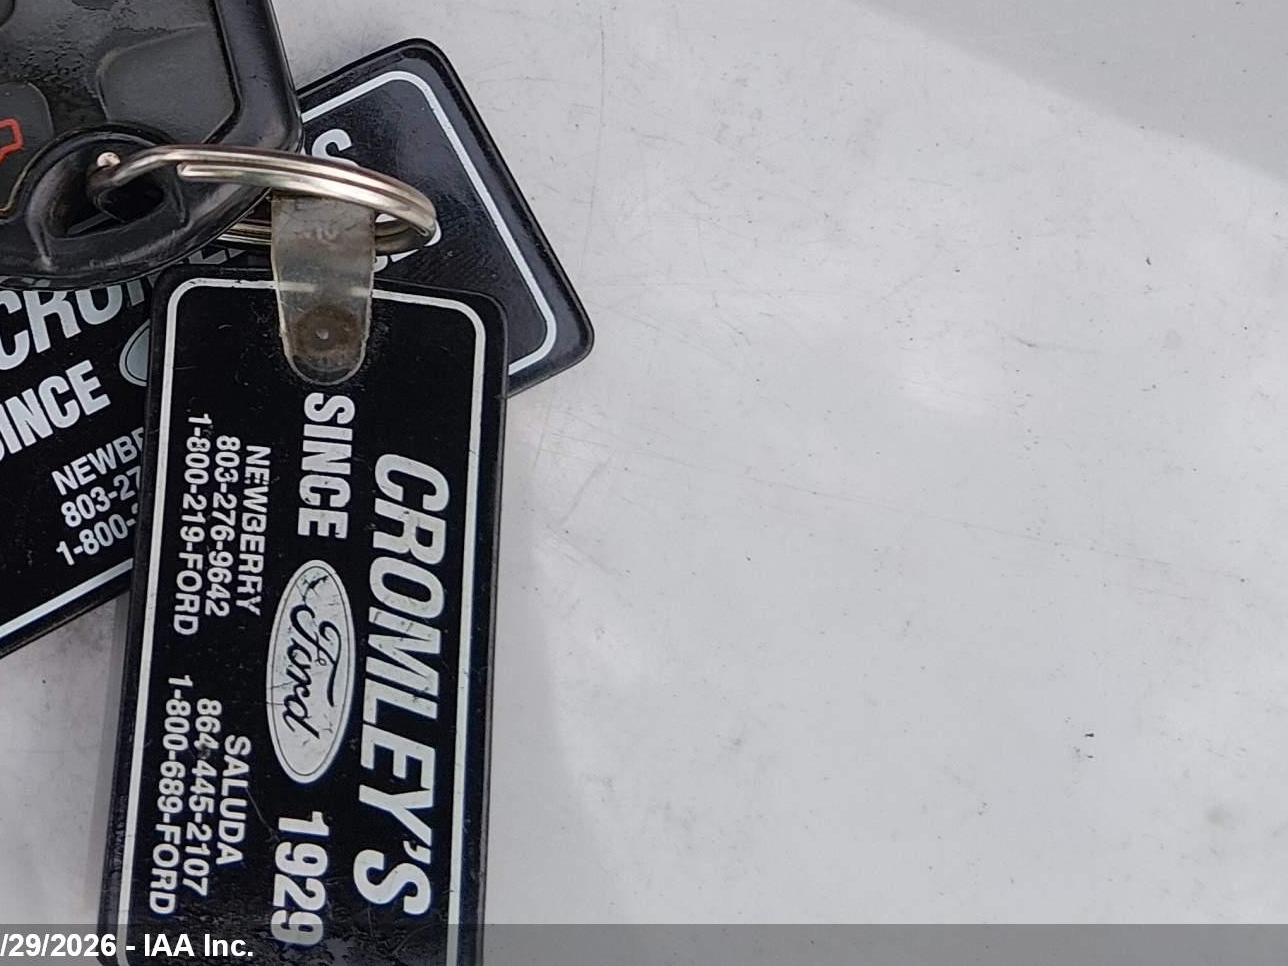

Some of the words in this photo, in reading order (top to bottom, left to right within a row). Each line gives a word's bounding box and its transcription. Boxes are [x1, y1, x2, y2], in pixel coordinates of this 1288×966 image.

[56, 502, 139, 566] 1-800-
[173, 413, 212, 636] 1-800-219-FORD
[205, 435, 241, 617] 803-276-9642
[236, 445, 271, 617] NEWBERRY
[297, 392, 355, 539] SINCE
[283, 605, 343, 740] Ford
[353, 454, 450, 915] CROMLEY'S
[150, 674, 193, 915] 1-800-689-FORD
[183, 698, 222, 897] 864-445-2107
[216, 734, 251, 865] SALUDA
[270, 811, 330, 946] 1929
